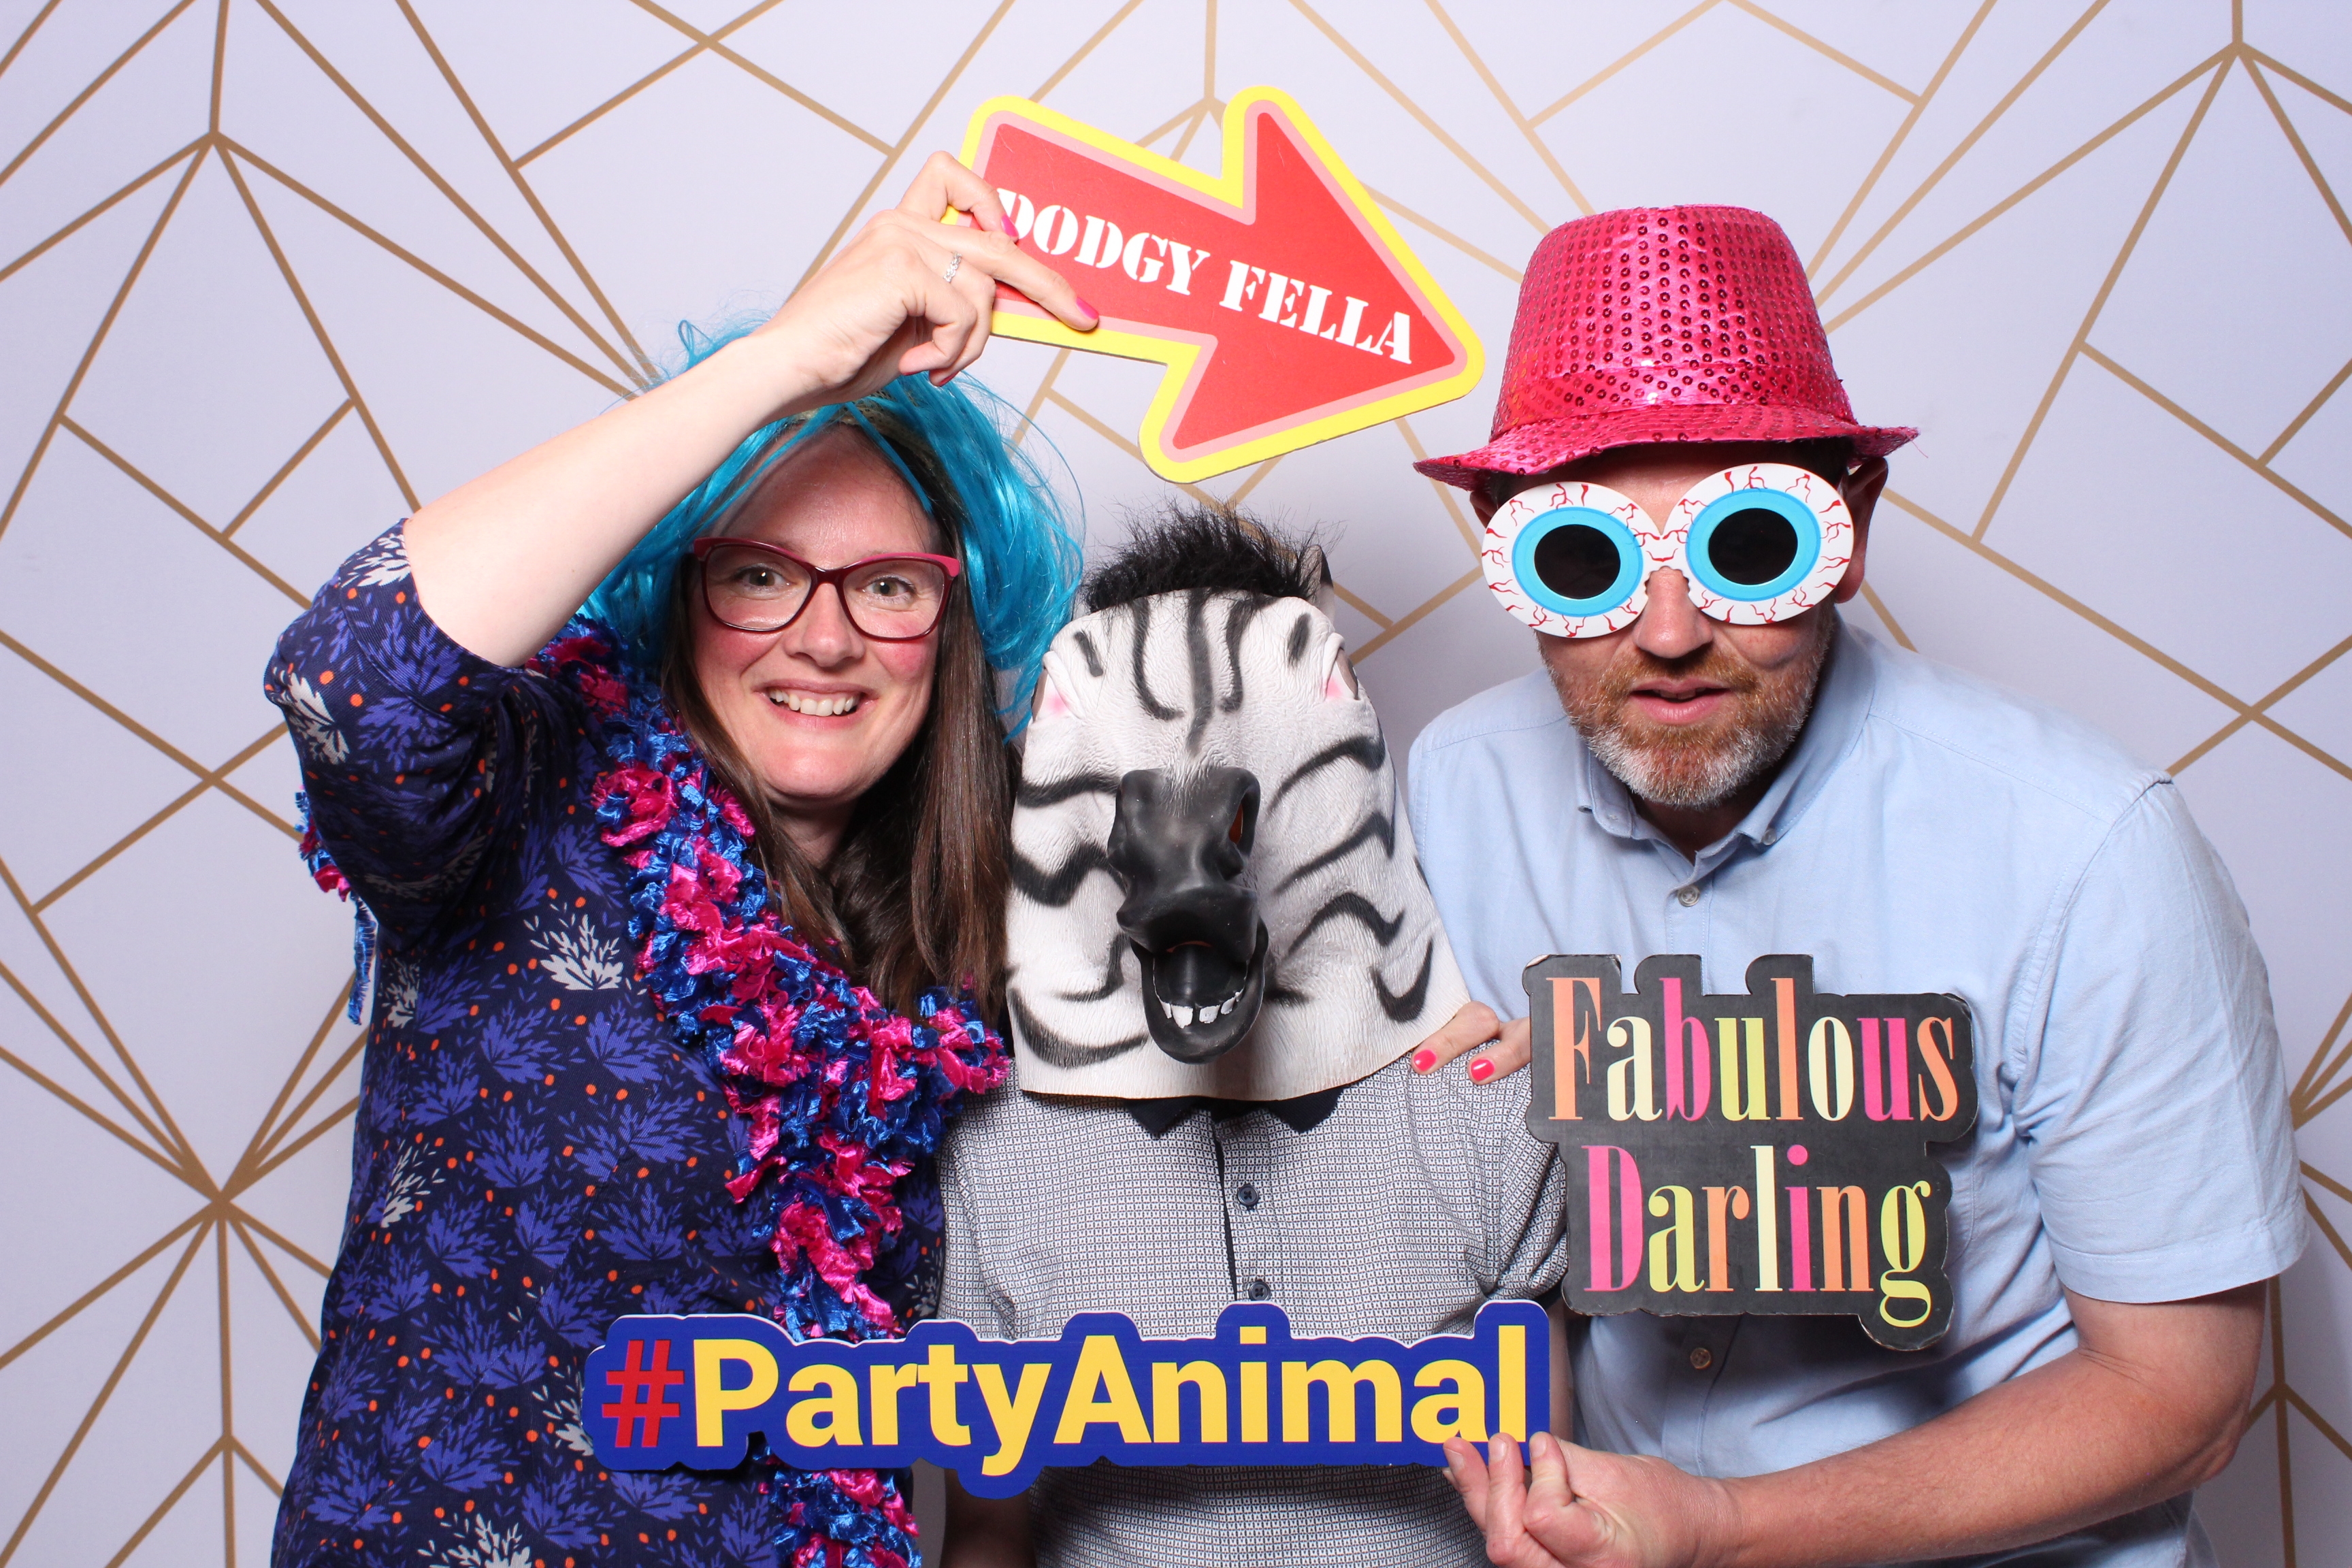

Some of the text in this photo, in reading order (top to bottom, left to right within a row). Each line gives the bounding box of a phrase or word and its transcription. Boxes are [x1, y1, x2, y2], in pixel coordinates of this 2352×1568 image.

[996, 188, 1412, 364] DODGY FELLA
[1546, 977, 1959, 1122] Fabulous
[1581, 1144, 1931, 1327] Darling
[601, 1325, 1526, 1476] #PartyAnimal
